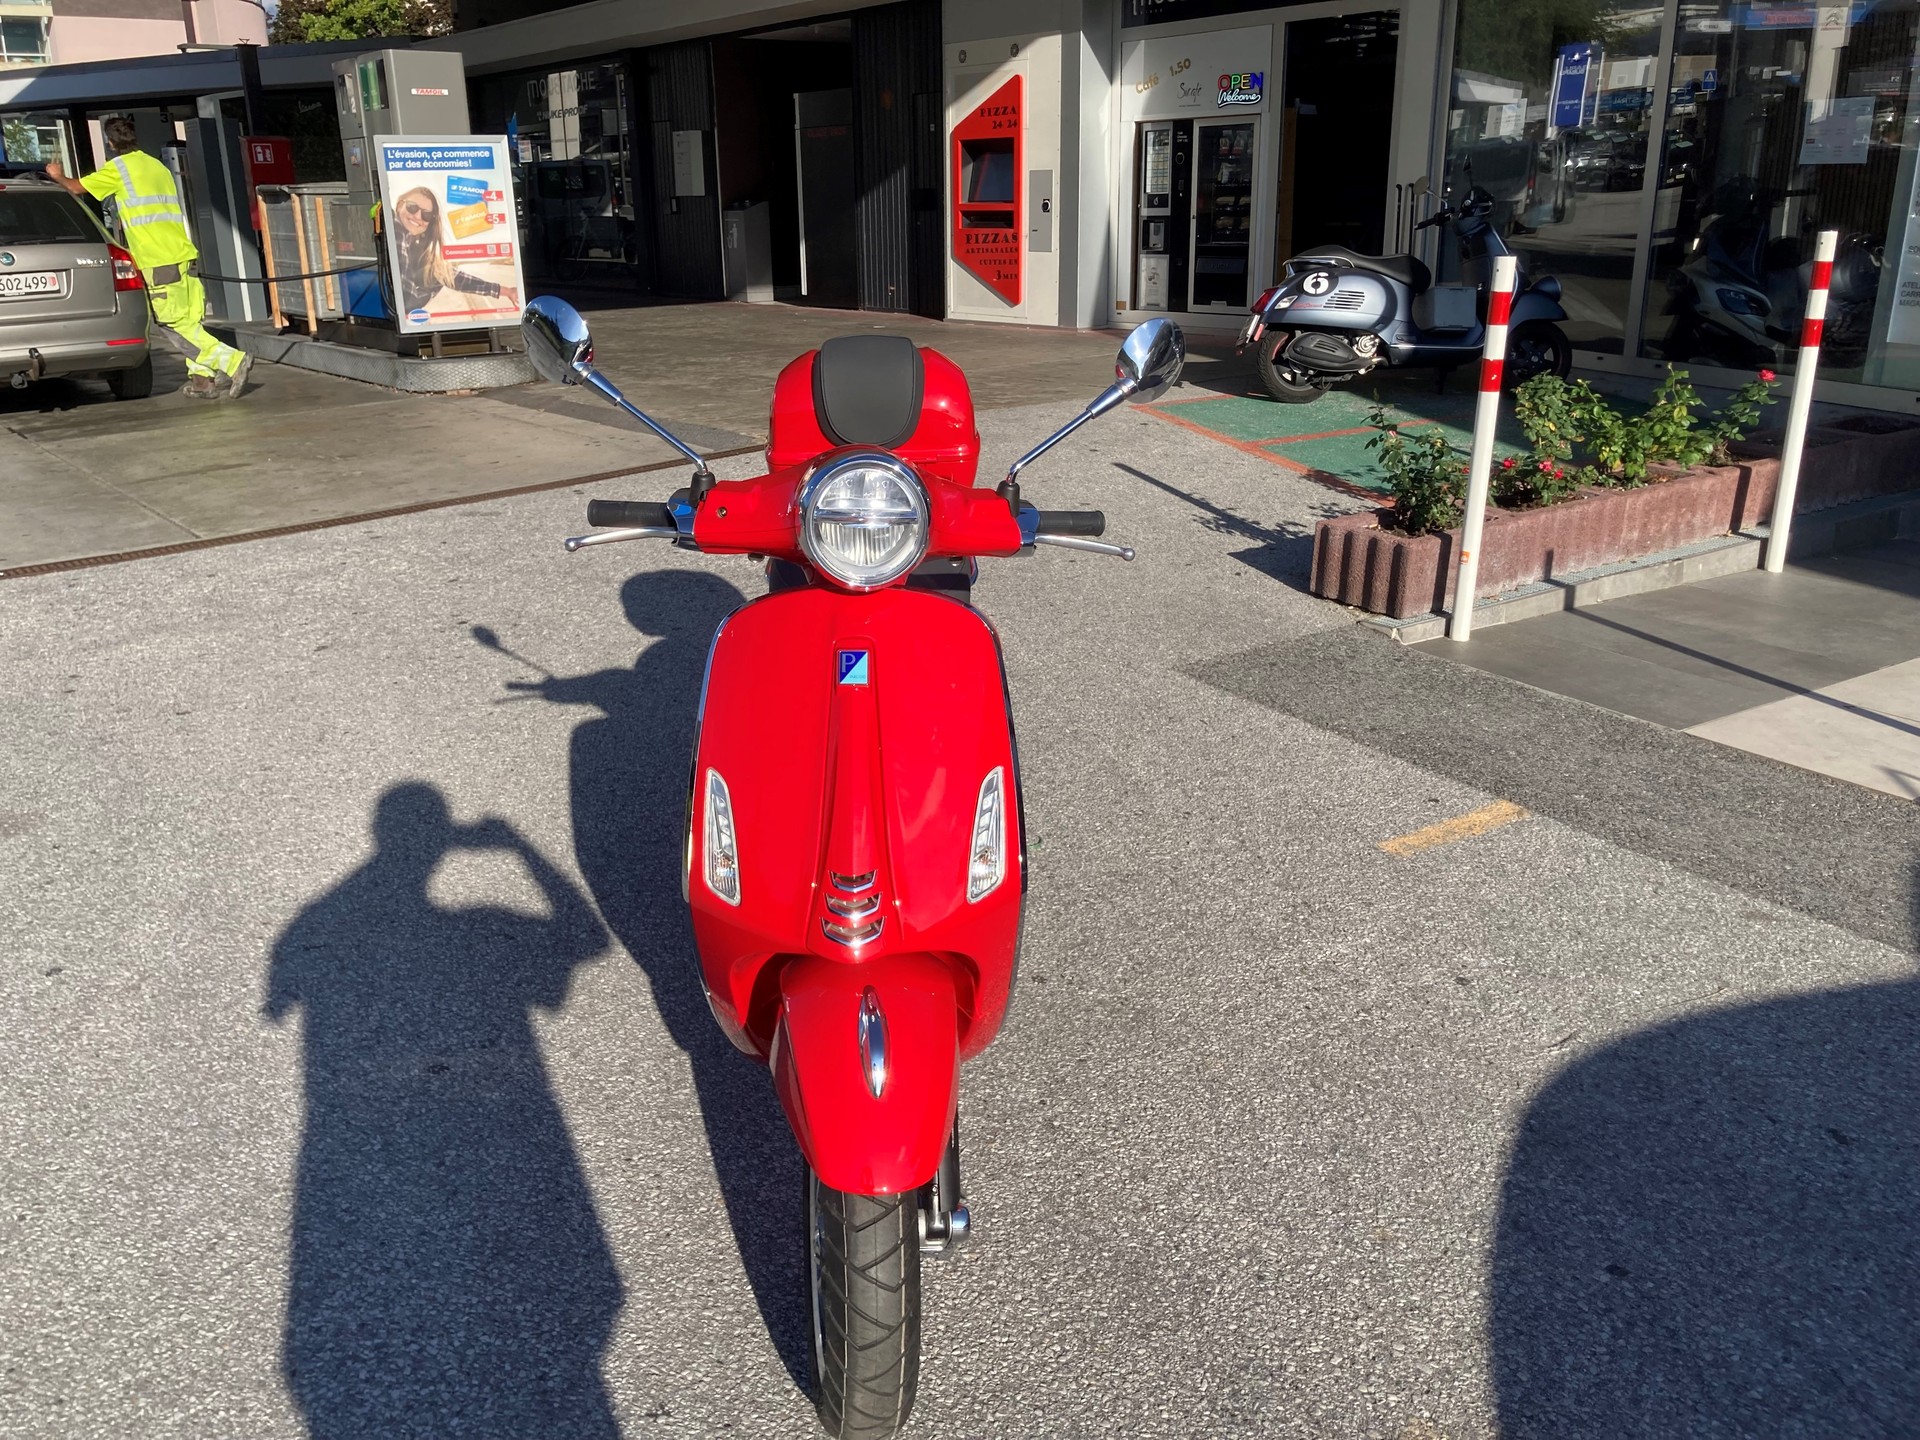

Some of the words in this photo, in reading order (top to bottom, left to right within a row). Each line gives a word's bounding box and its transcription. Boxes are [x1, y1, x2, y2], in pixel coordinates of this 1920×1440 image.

[1135, 74, 1159, 94] Café
[1169, 58, 1191, 77] 1.50
[1217, 72, 1264, 91] OPEN
[1217, 88, 1262, 108] Welcome
[980, 105, 1017, 117] PIZZA
[387, 149, 430, 160] L'évasion,
[431, 151, 442, 159] ça
[443, 150, 490, 158] commence
[389, 161, 404, 170] par
[405, 160, 421, 168] des
[965, 232, 1018, 245] PIZZAS
[1303, 271, 1329, 295] 6
[1901, 281, 1920, 289] ATEL
[841, 653, 856, 673] P
